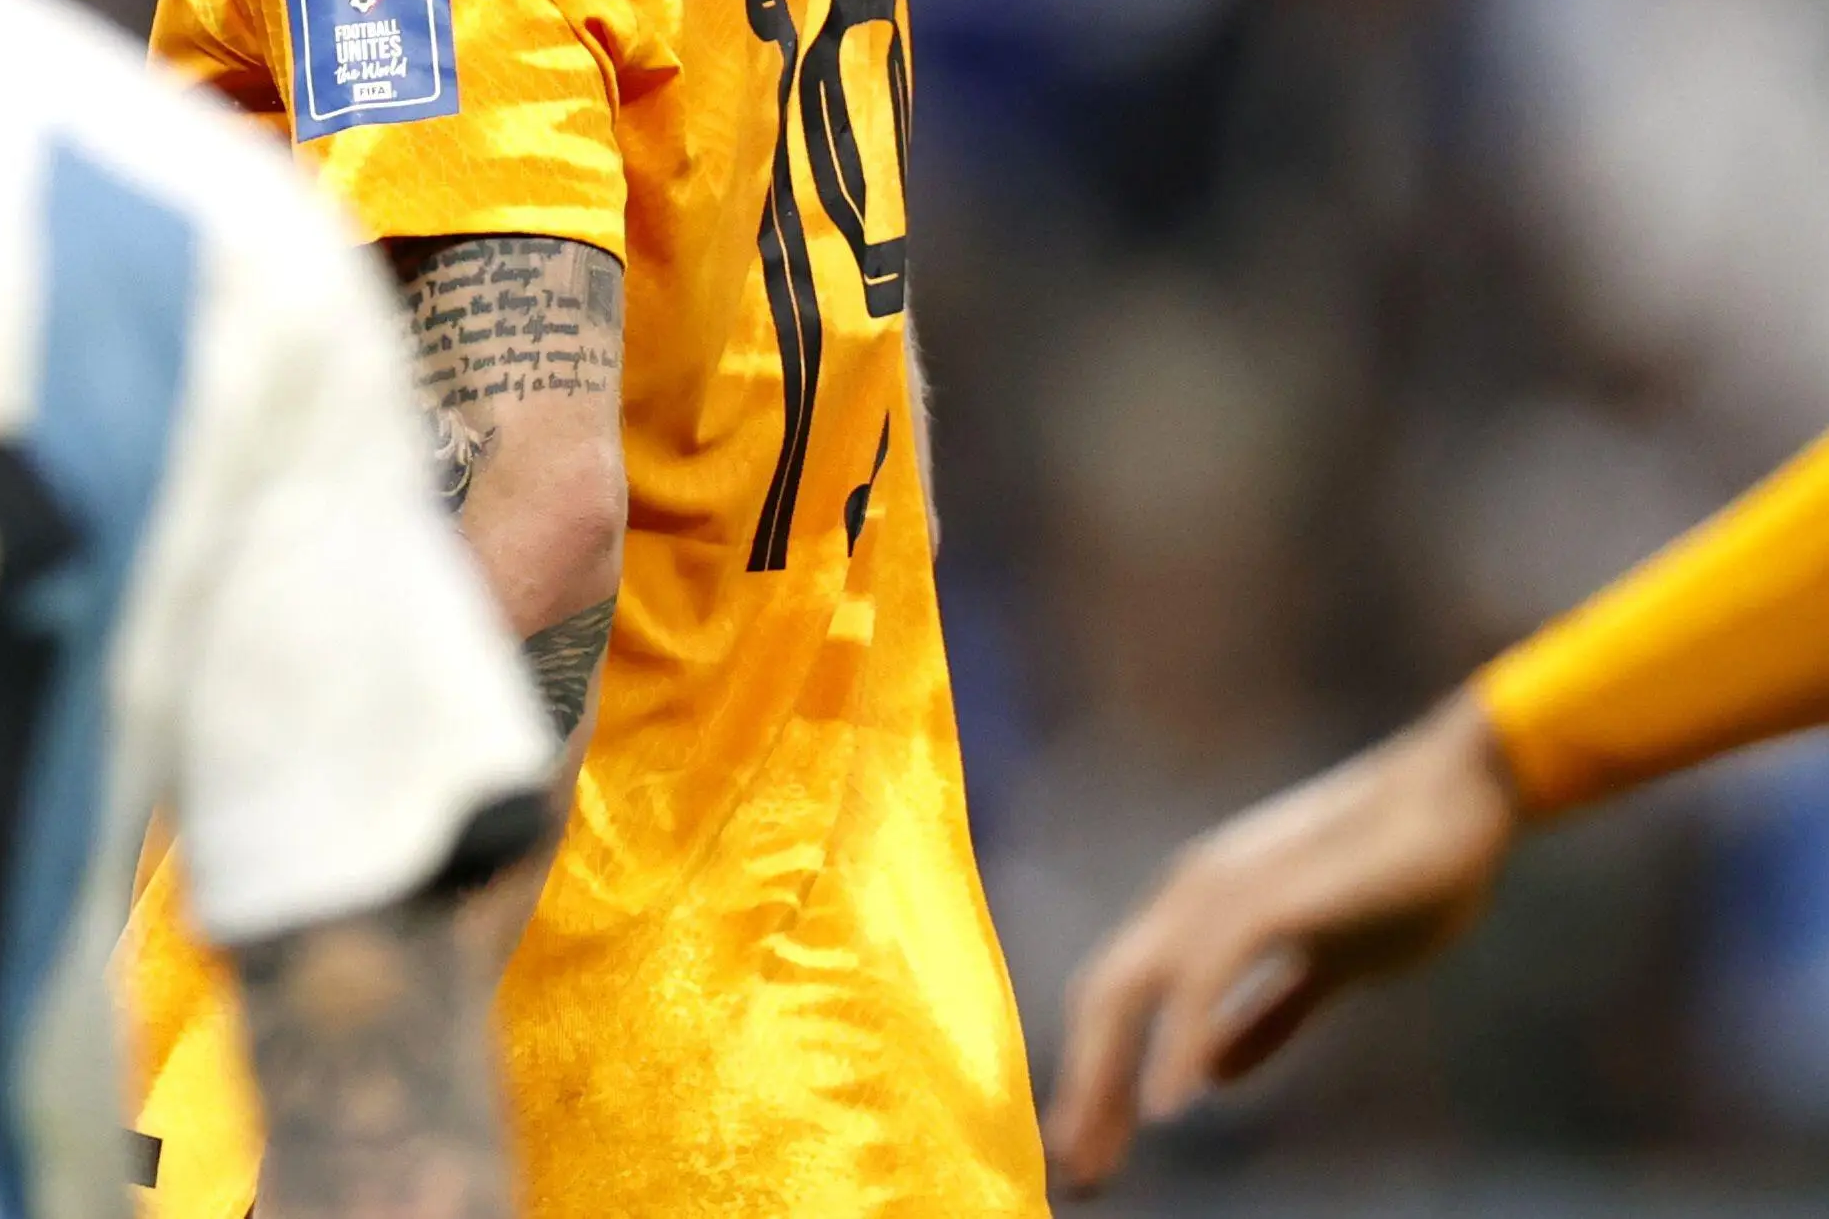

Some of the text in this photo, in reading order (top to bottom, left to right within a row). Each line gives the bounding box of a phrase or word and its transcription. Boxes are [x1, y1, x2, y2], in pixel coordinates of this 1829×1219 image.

[334, 18, 401, 42] FOOTBALL
[336, 34, 403, 64] UNITES
[333, 56, 408, 85] the World
[359, 86, 385, 96] FIFA
